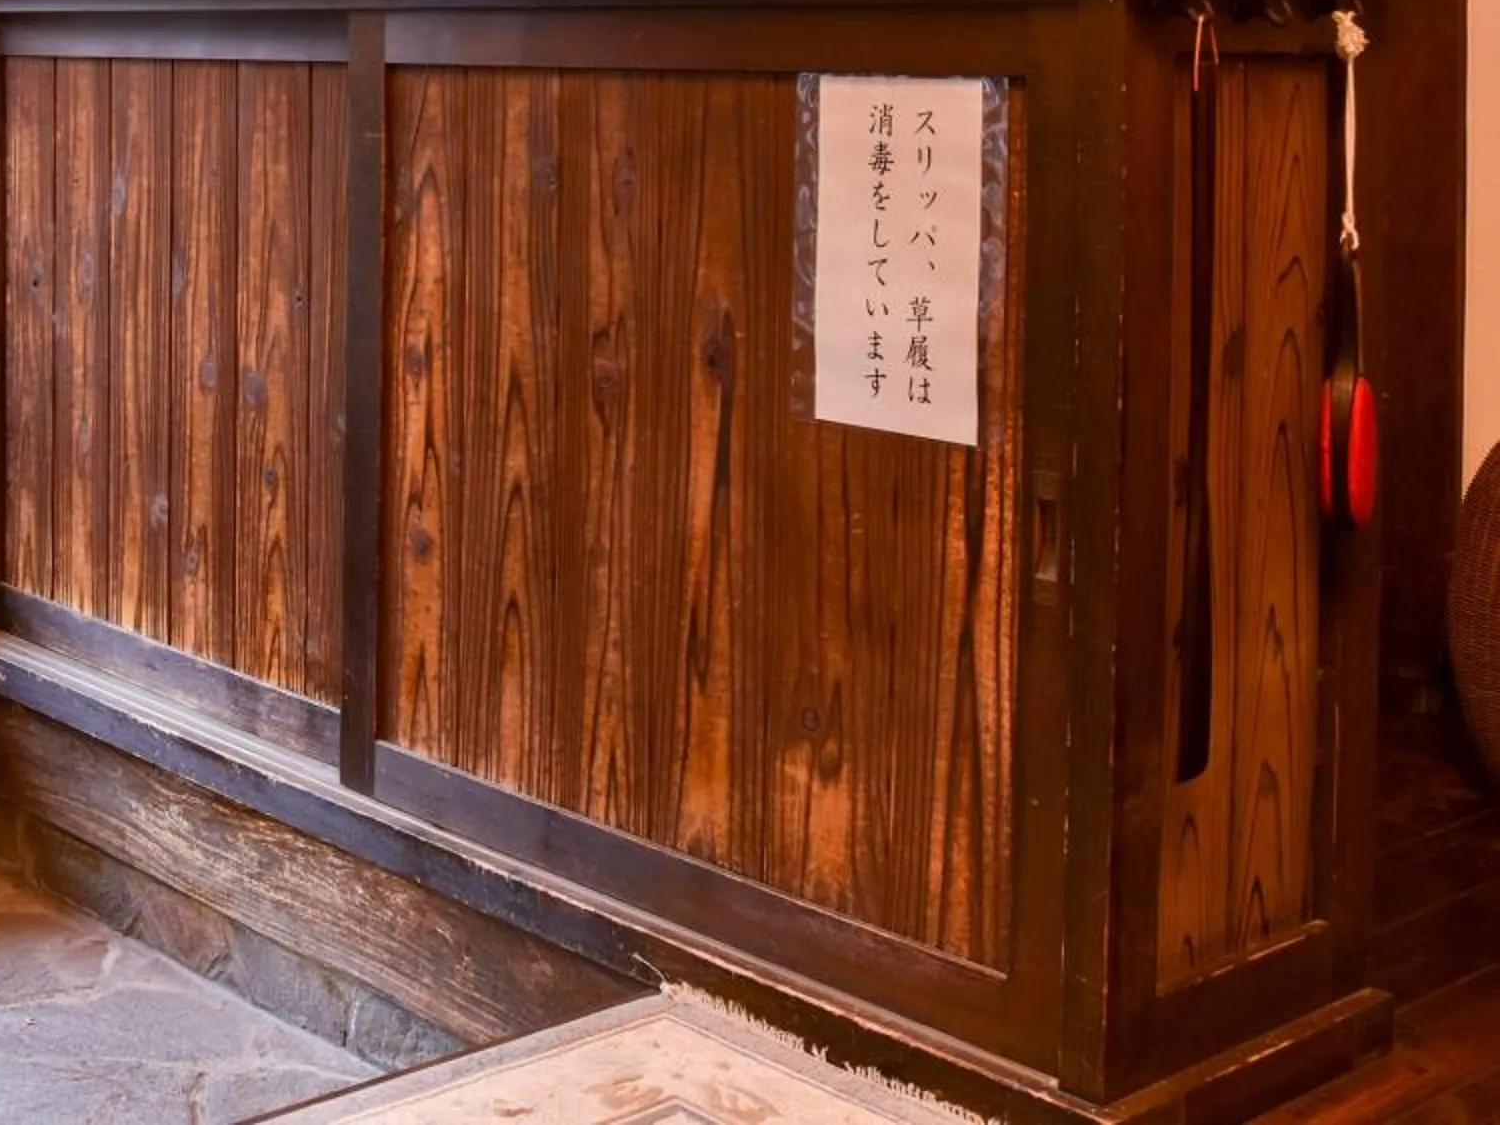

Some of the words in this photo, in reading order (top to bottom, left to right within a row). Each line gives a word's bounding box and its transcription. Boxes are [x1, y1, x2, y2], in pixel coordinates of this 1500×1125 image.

[864, 105, 896, 399] 消毒をしています
